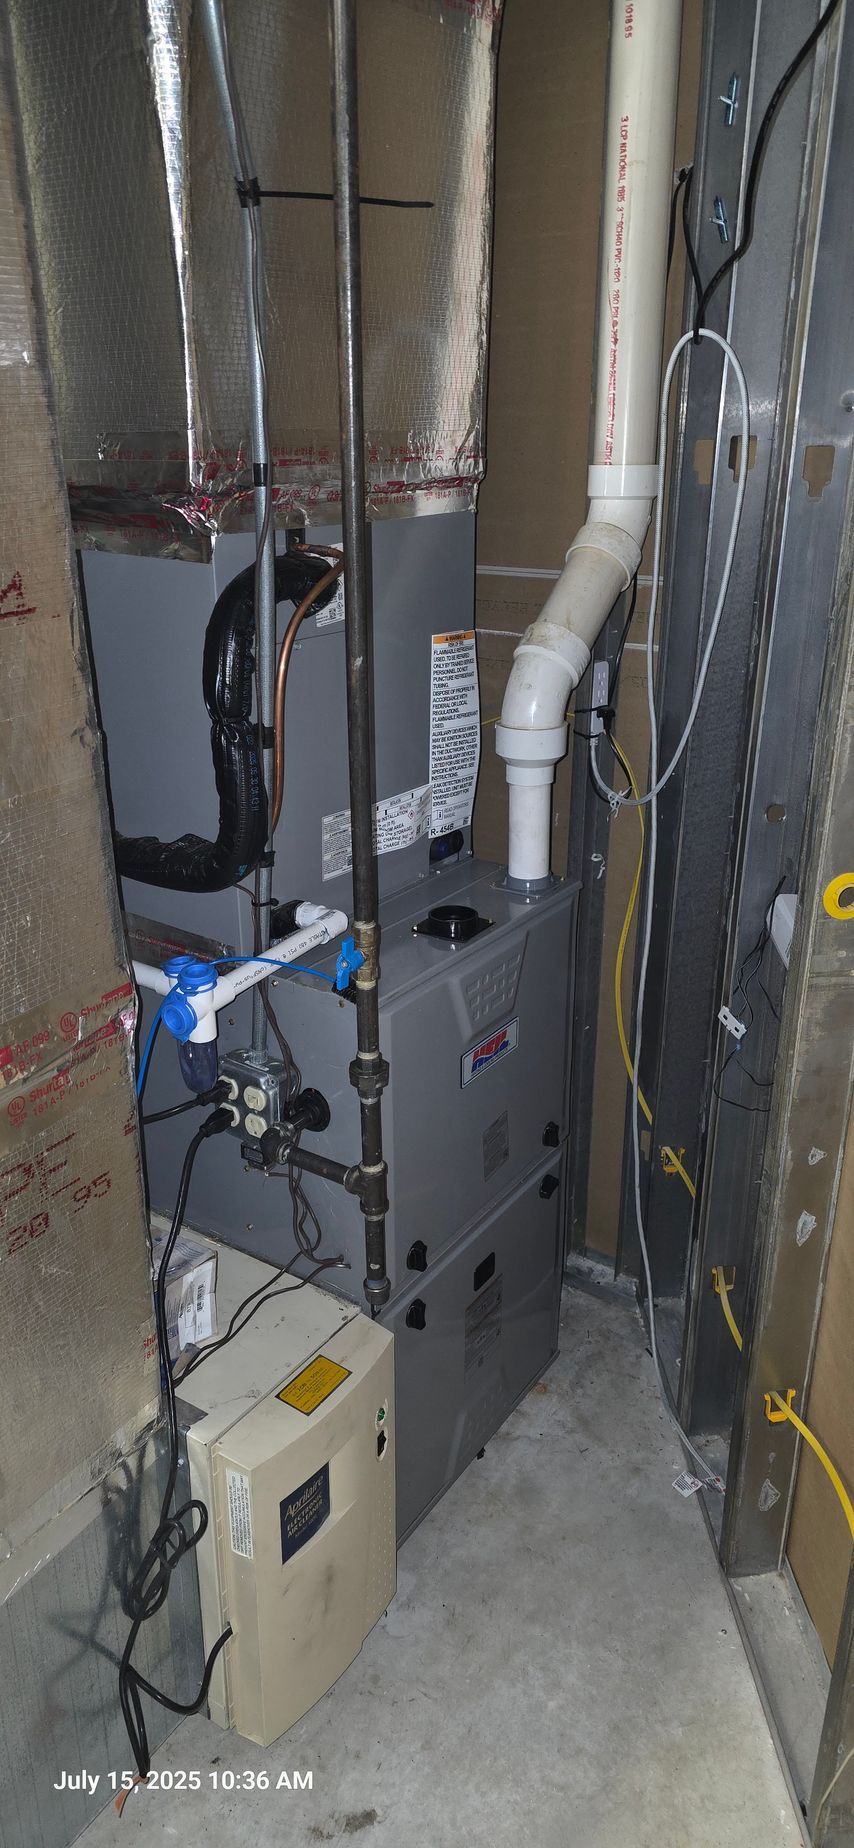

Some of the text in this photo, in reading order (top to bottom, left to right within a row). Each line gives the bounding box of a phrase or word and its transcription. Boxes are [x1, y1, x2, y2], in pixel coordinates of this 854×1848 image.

[618, 142, 628, 183] NATIONAL
[433, 674, 454, 682] PUNCTURE
[32, 1030, 50, 1048] 099
[73, 1170, 111, 1214] 95
[285, 1476, 323, 1520] Aprilaire
